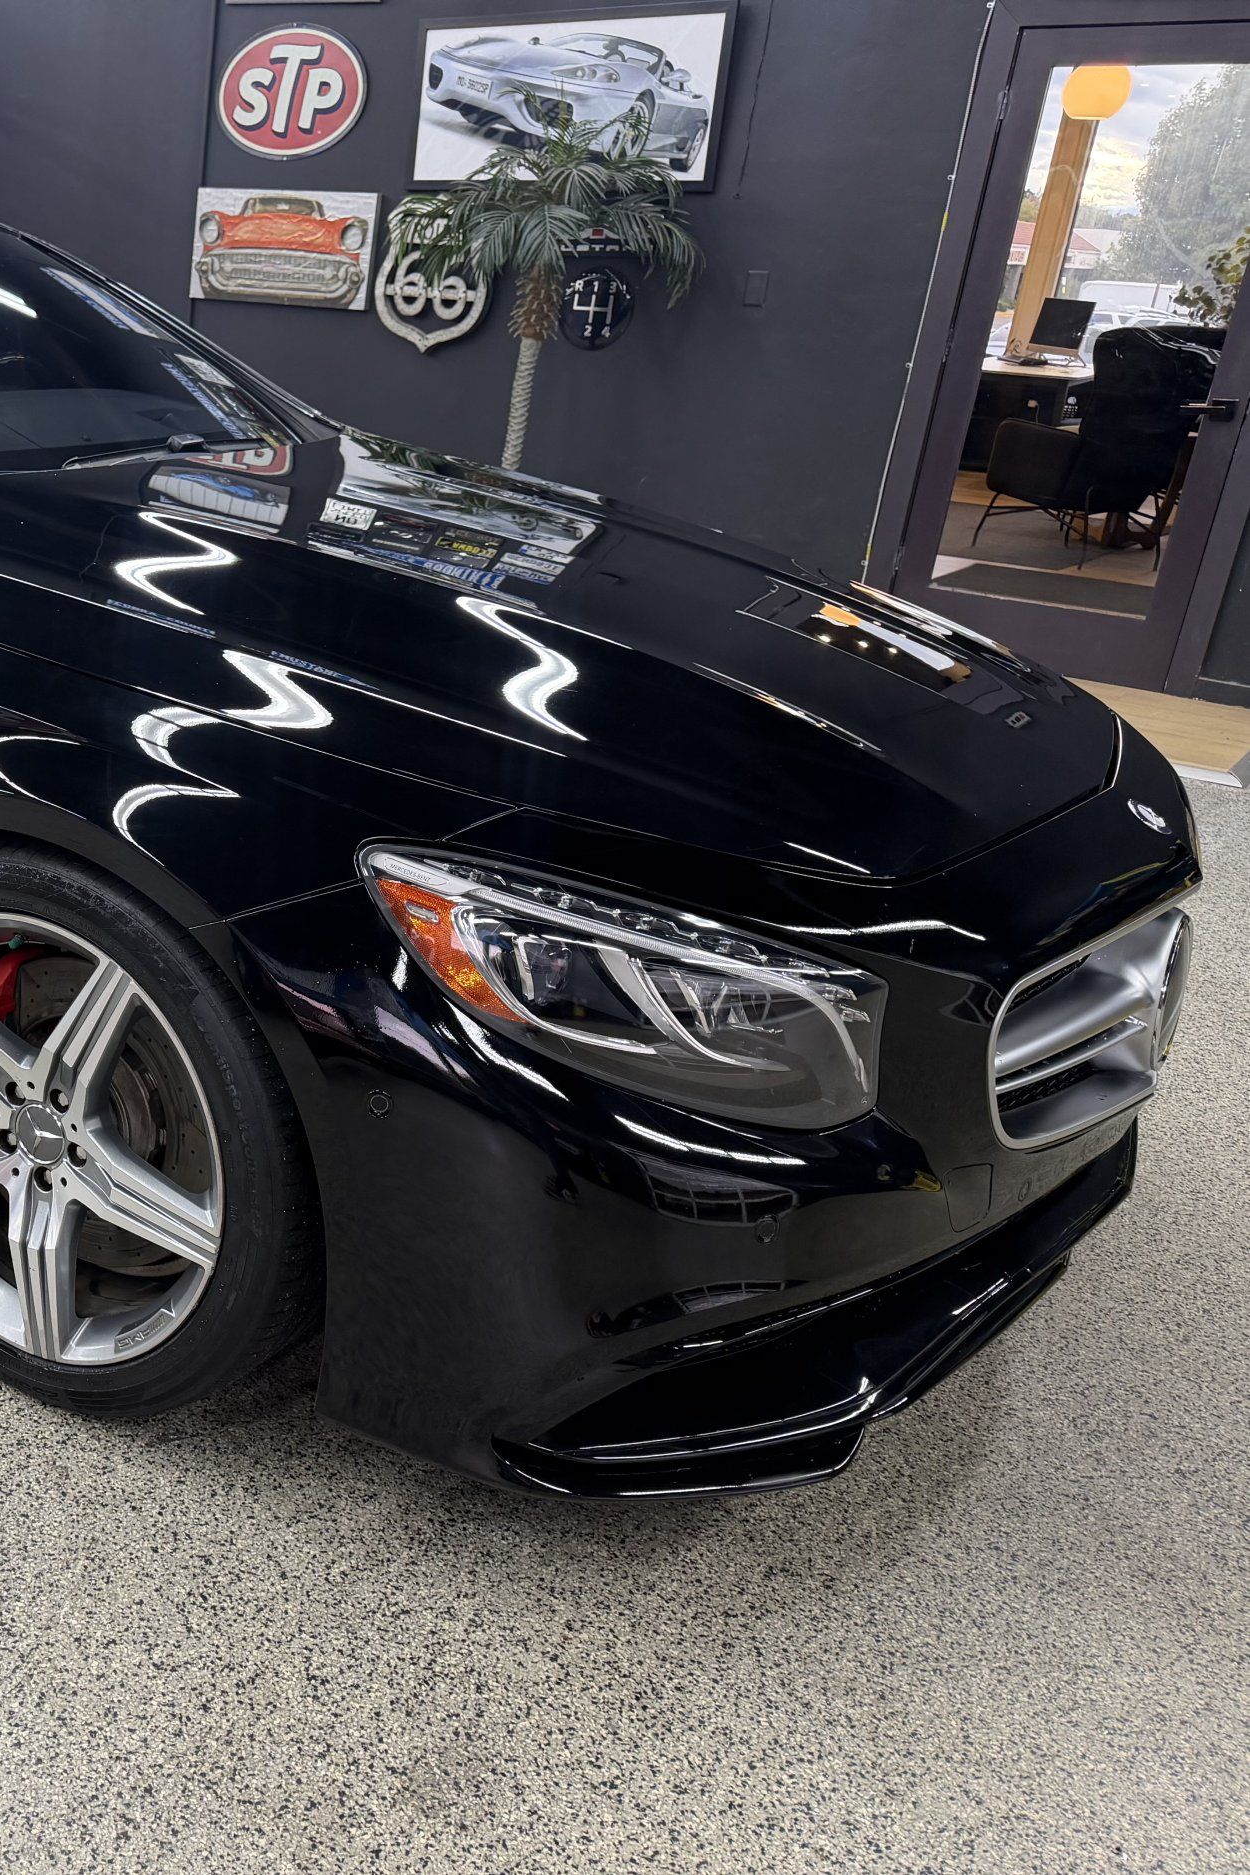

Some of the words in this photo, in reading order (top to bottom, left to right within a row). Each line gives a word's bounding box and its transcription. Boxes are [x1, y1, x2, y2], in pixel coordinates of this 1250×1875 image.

[232, 43, 344, 136] STP
[393, 250, 467, 320] 66
[575, 280, 584, 291] R
[593, 280, 599, 292] 1
[609, 281, 617, 293] 3
[584, 325, 592, 337] 2
[601, 326, 610, 338] 4
[390, 863, 431, 882] MERCEDES-BENZ
